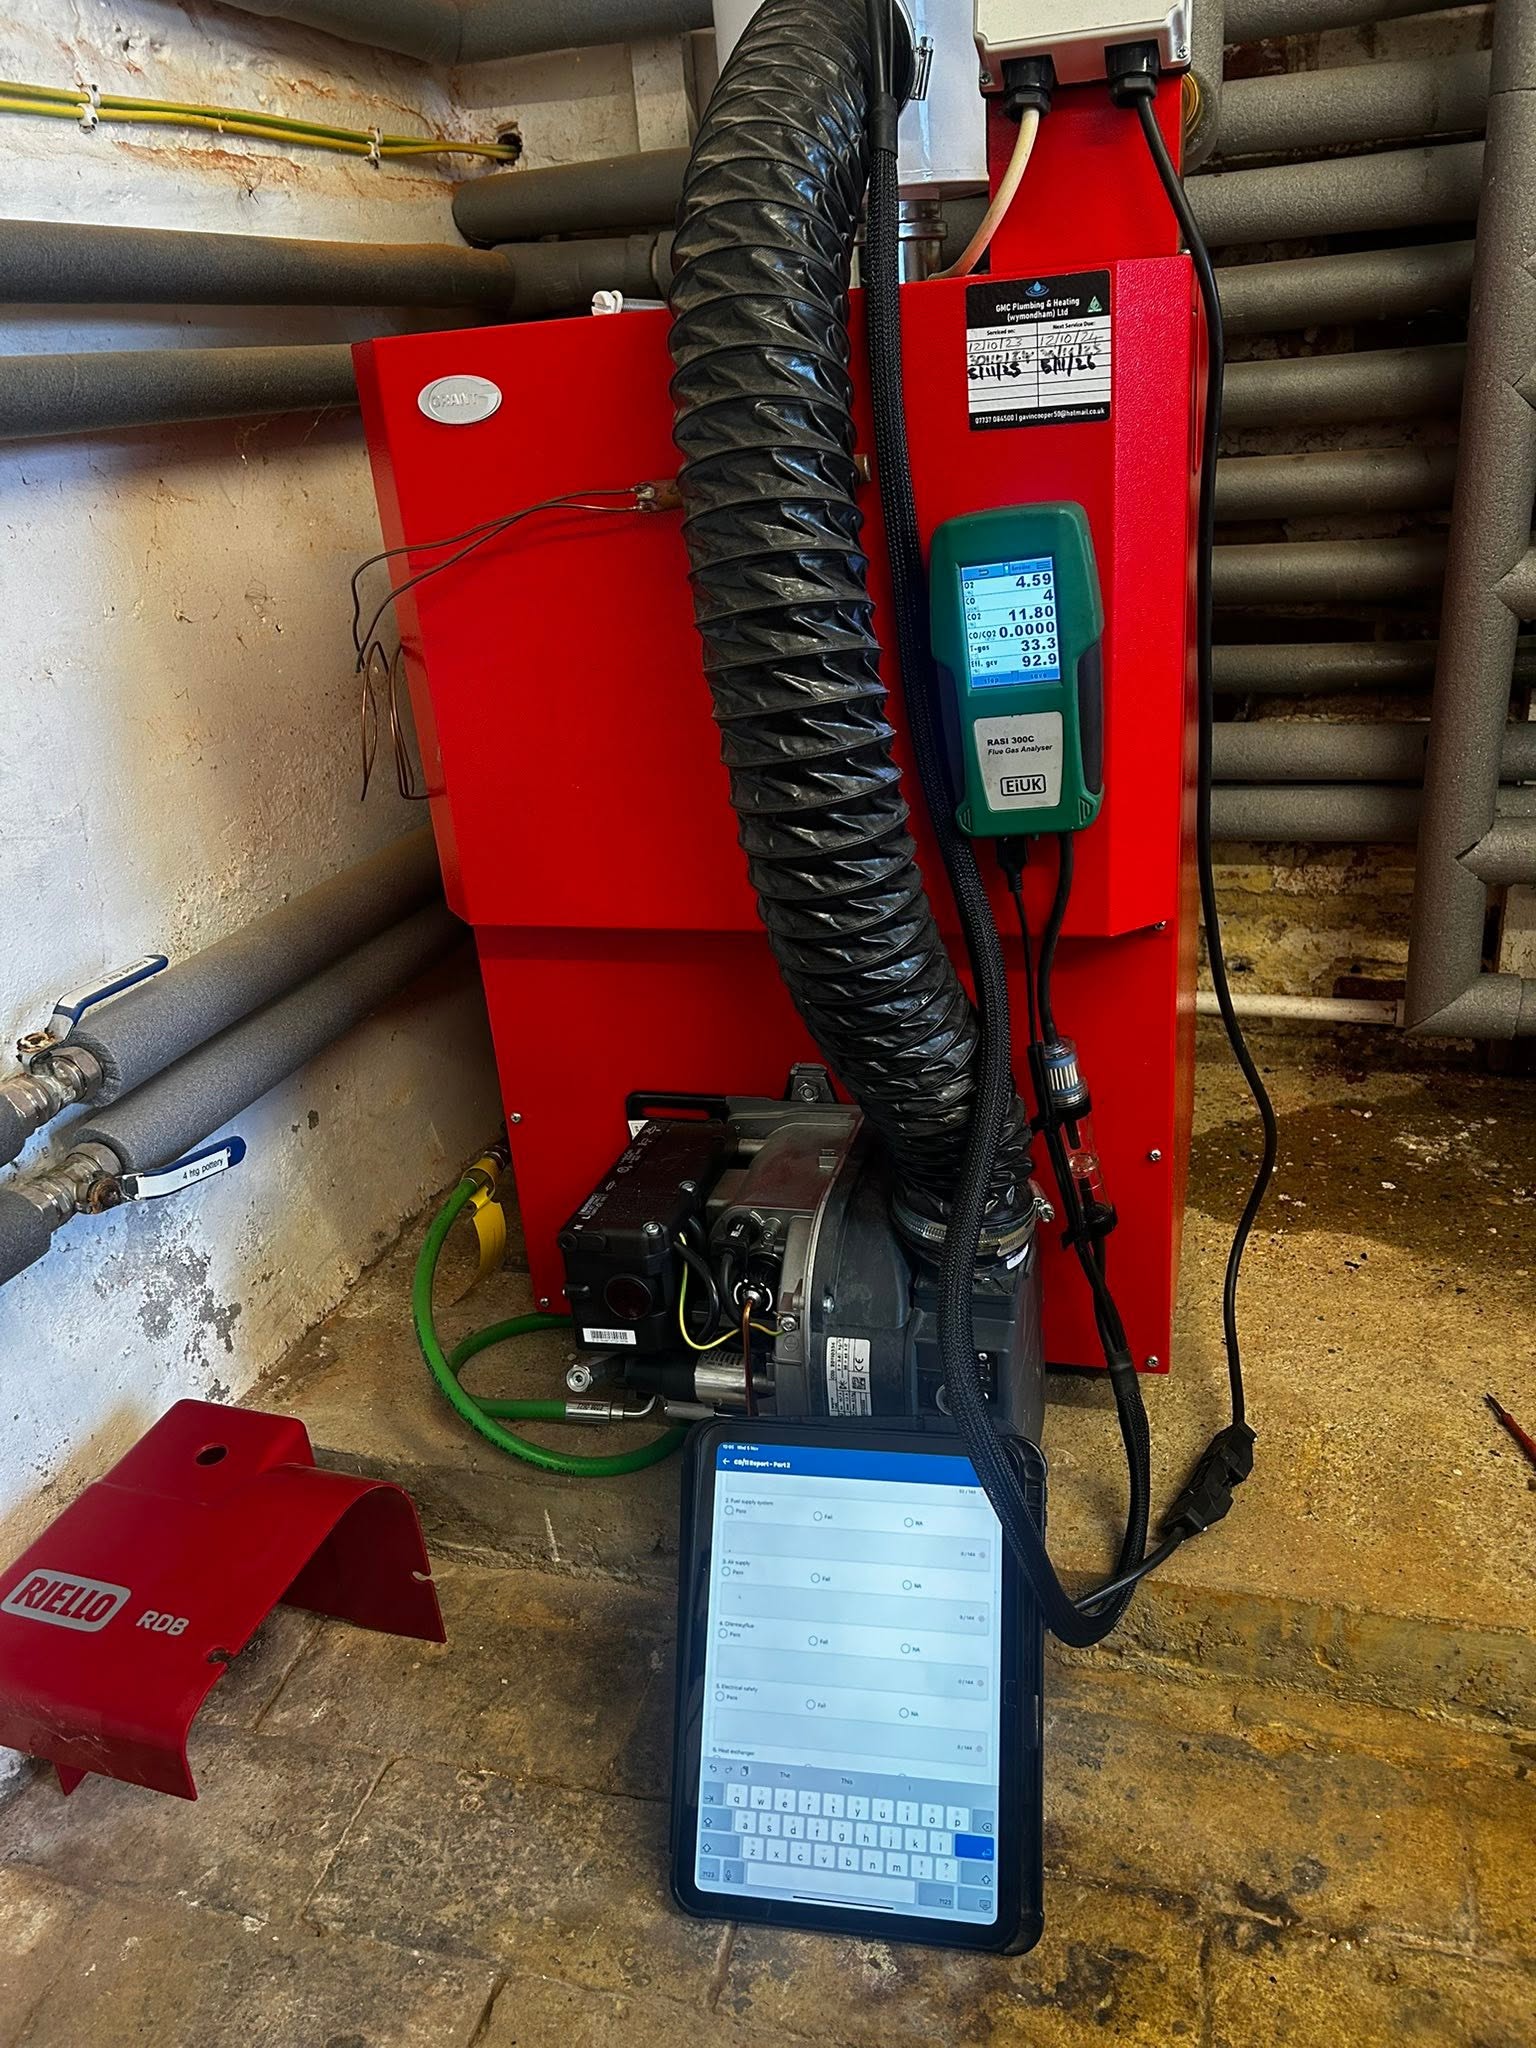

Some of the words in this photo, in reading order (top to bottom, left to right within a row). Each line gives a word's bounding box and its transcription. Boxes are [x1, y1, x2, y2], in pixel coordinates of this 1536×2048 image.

[996, 303, 1010, 312] GMC
[1012, 300, 1044, 312] Plumbing
[1053, 298, 1080, 308] Heating
[1007, 310, 1056, 322] (wymondham)
[1057, 308, 1068, 316] Ltd
[986, 328, 1006, 336] Serviced
[1040, 330, 1103, 346] 12/10/24
[969, 337, 1022, 352] 12/10/23
[975, 416, 992, 424] 07737
[1018, 408, 1105, 422] gavincooper50@hotmail.co.uk
[1016, 573, 1052, 588] 4.59
[1043, 589, 1054, 601] 4
[967, 612, 981, 620] CO2
[1008, 606, 1054, 621] 11.80
[968, 630, 996, 640] CO/CO2
[998, 622, 1055, 638] 0.0000
[1021, 637, 1056, 652] 33.3
[1022, 653, 1057, 668] 92.9
[987, 738, 1009, 746] RASI
[1011, 736, 1034, 744] 300C
[988, 748, 1004, 756] Flue
[1020, 744, 1053, 753] Analyser
[1006, 778, 1042, 792] EiUK
[182, 1172, 188, 1180] 4
[202, 1158, 224, 1173] pottery
[750, 1460, 770, 1468] Report
[11, 1576, 118, 1623] RIELLO
[136, 1610, 190, 1636] RDB
